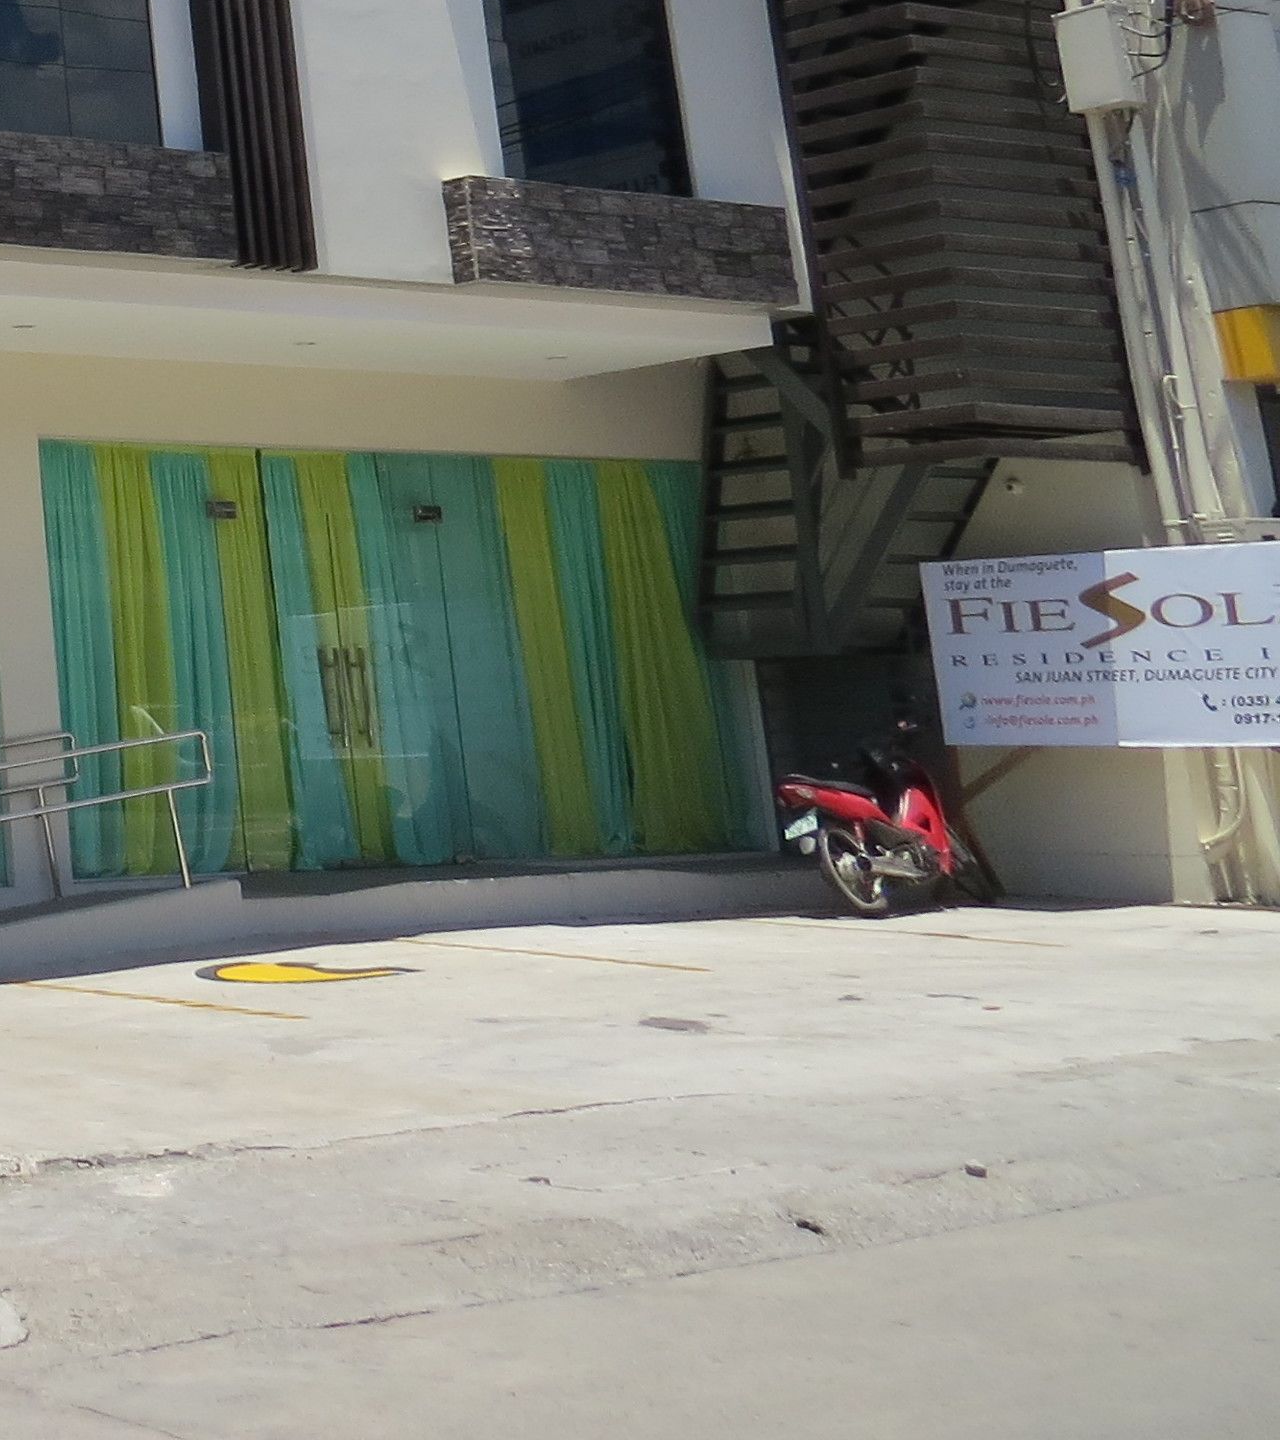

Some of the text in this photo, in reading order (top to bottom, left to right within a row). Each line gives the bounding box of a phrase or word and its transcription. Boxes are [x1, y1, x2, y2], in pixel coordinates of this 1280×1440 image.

[942, 564, 979, 576] When
[982, 562, 993, 574] in
[944, 577, 1013, 593] stay at the
[944, 571, 1280, 650] FIESOL
[951, 648, 1224, 667] RESIDENCE
[1015, 666, 1277, 683] SAN JUAN STREET, DUMAGUETE CITY
[1231, 695, 1269, 707] (035)
